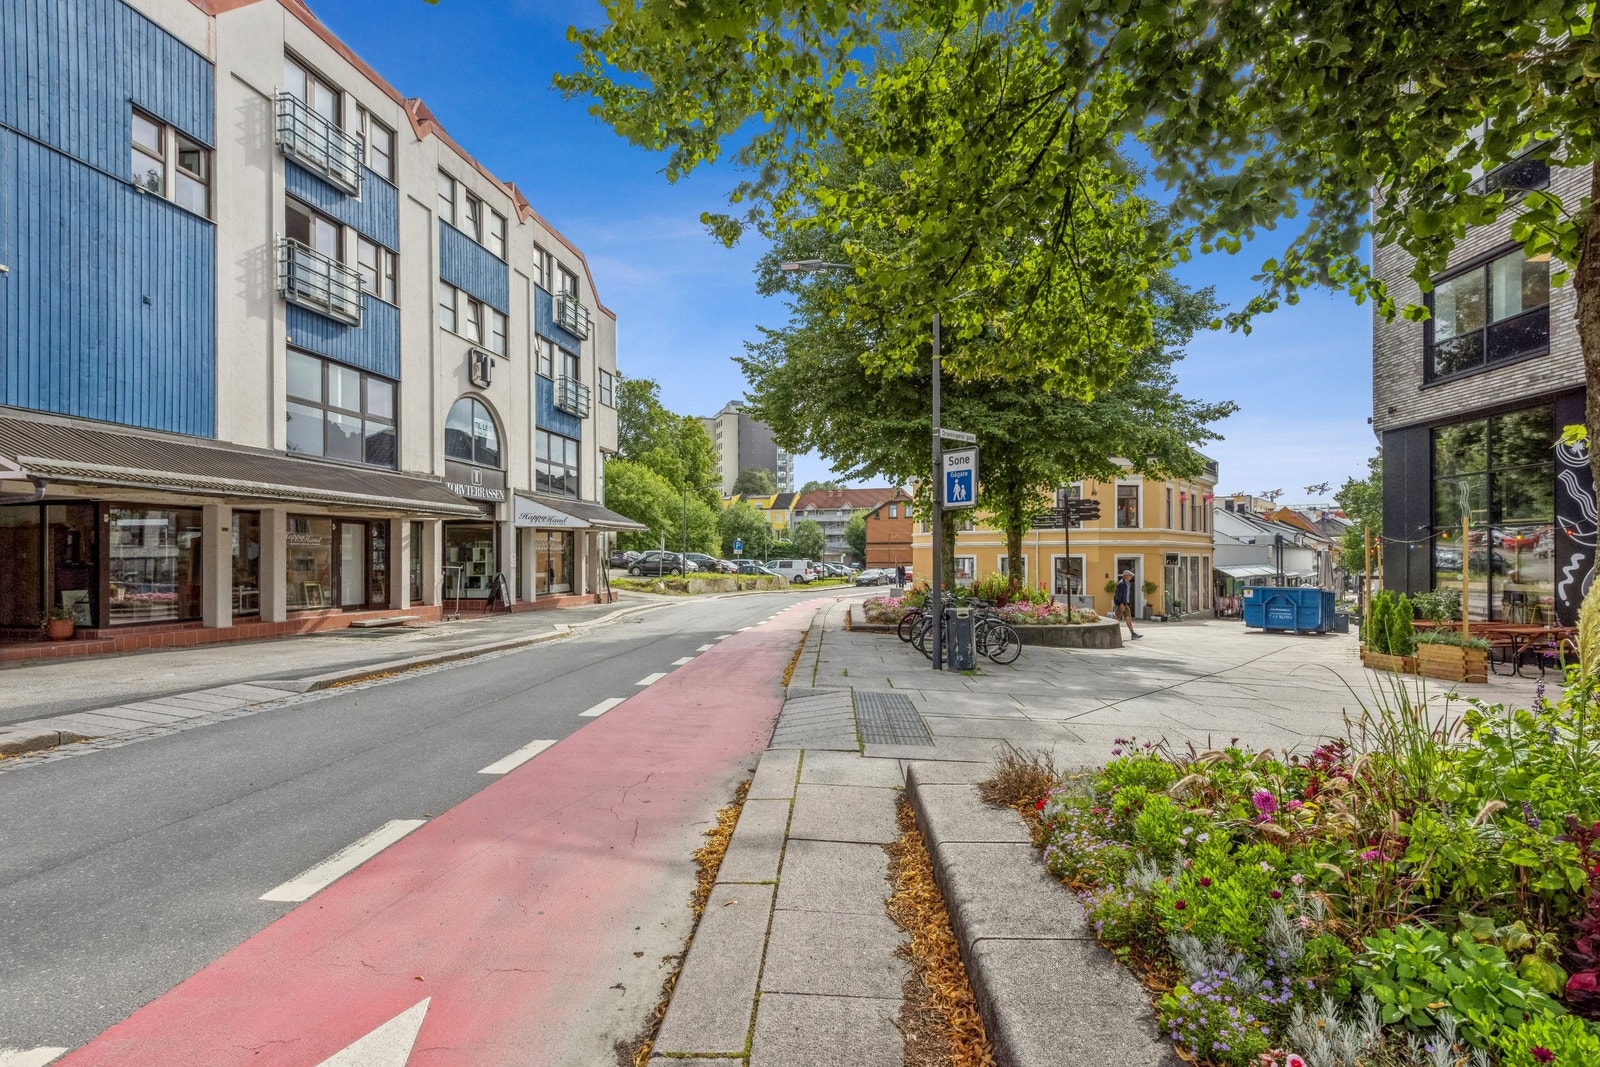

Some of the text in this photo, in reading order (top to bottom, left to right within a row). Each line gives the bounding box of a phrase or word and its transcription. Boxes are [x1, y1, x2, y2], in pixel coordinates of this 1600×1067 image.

[948, 456, 970, 466] Sone
[446, 481, 504, 500] TORVTERRASSEN
[519, 512, 568, 524] Happy Hand
